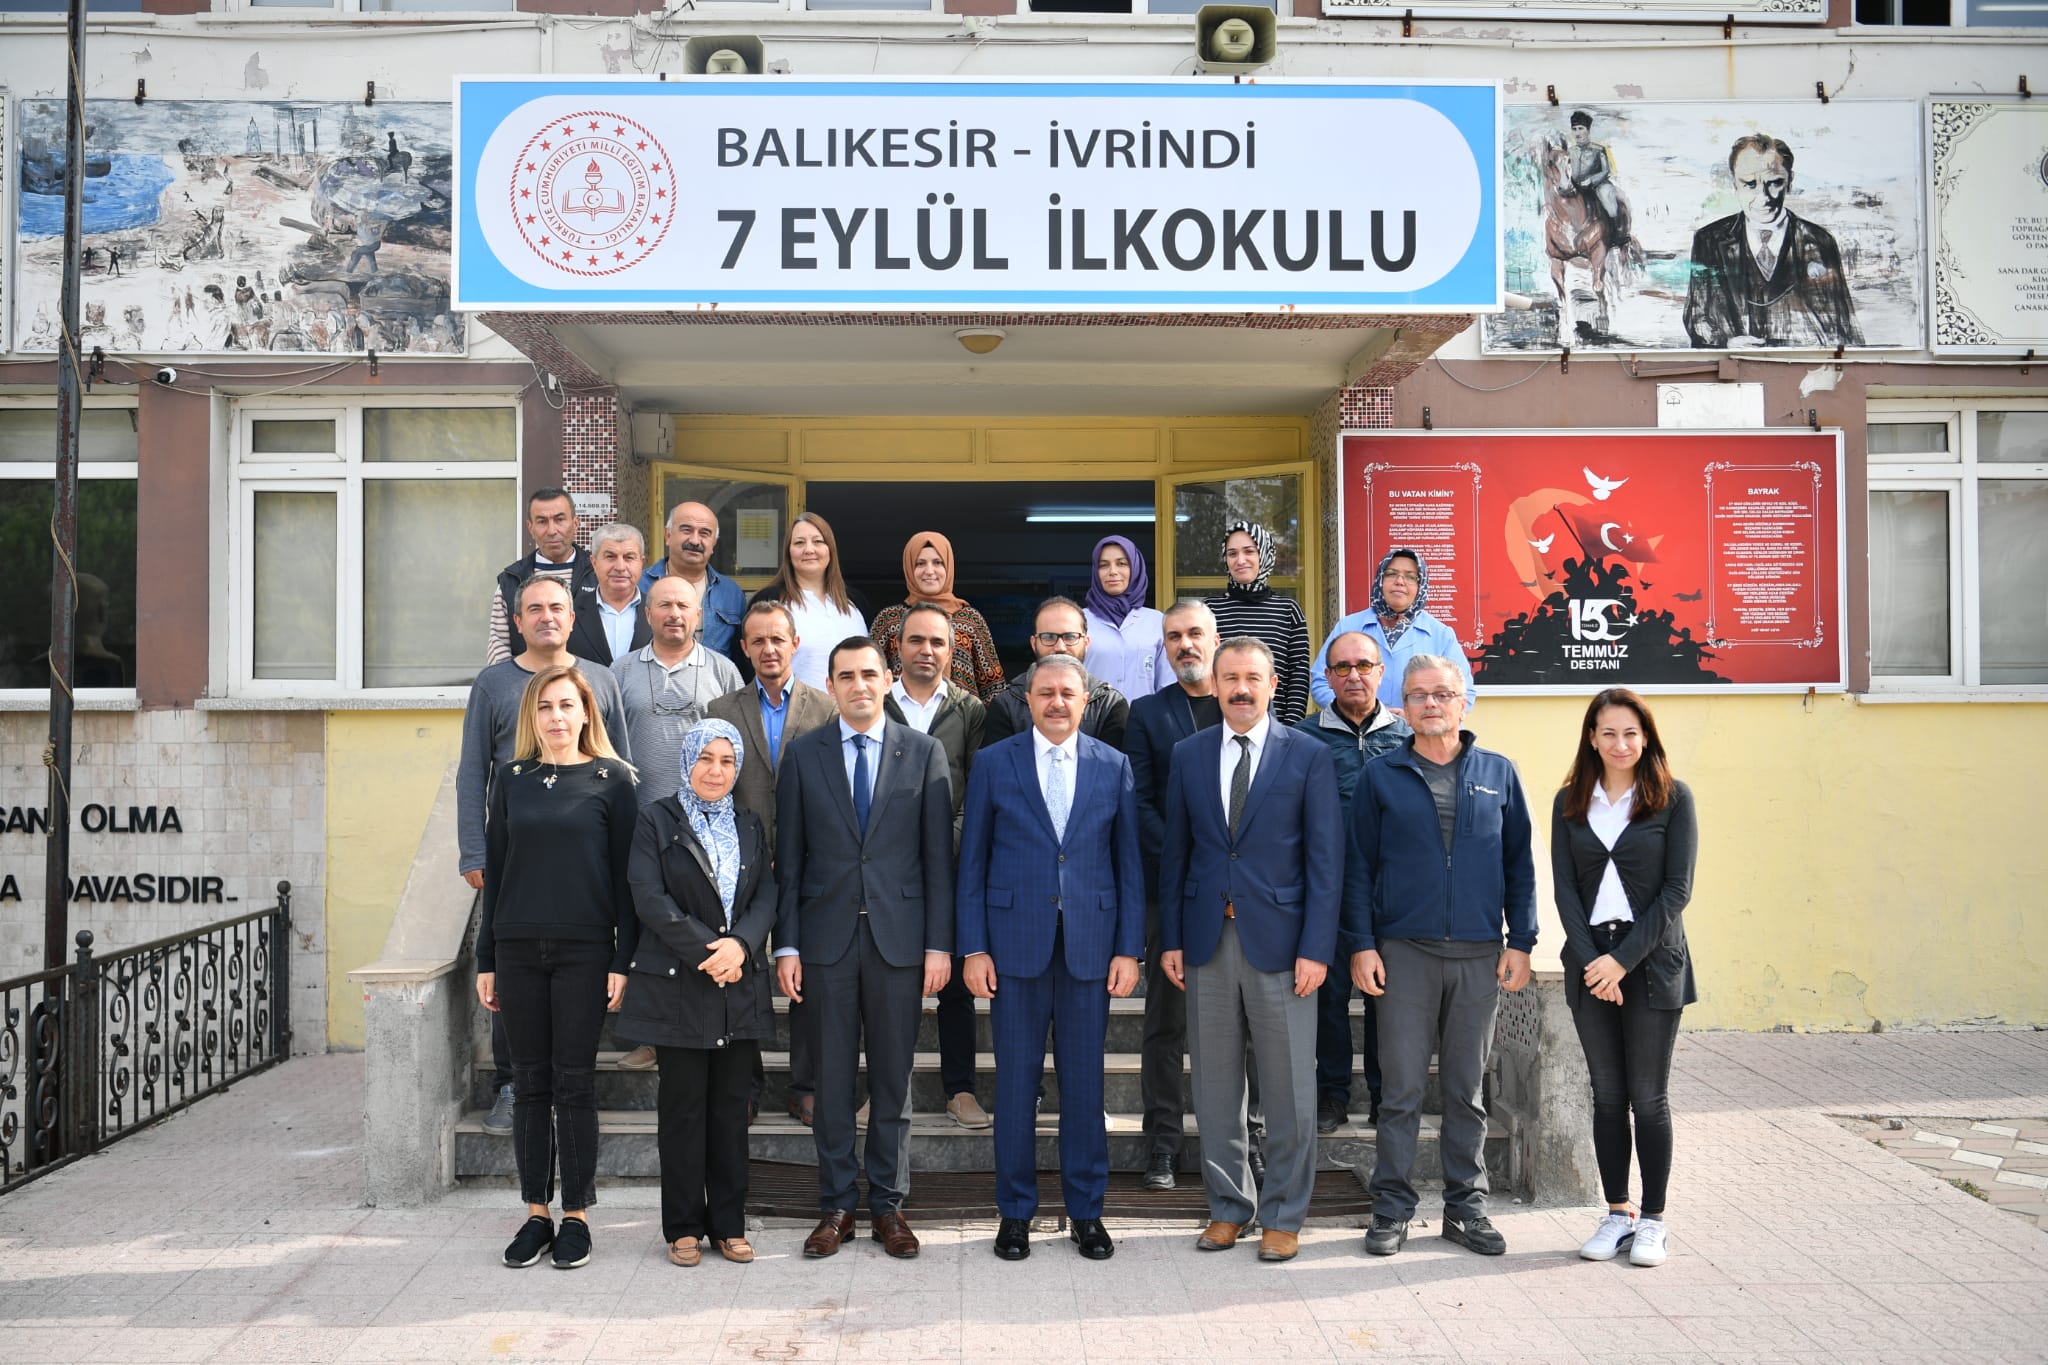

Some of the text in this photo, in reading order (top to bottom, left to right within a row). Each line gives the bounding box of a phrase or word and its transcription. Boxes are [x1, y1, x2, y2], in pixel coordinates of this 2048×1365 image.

[717, 119, 997, 168] BALIKESİR
[1049, 120, 1255, 169] İVRİNDİ
[541, 140, 646, 244] TÜRKİYE CUMHURİYETİ MİLLİ EĞİTİM BAKANLIĞI
[717, 192, 1417, 273] 7 EYLÜL İLKOKULU
[1389, 489, 1455, 498] BU VATAN KİMİN?
[1561, 645, 1629, 657] TEMMUZ
[1570, 660, 1620, 670] DESTANI
[80, 803, 184, 834] OLMA
